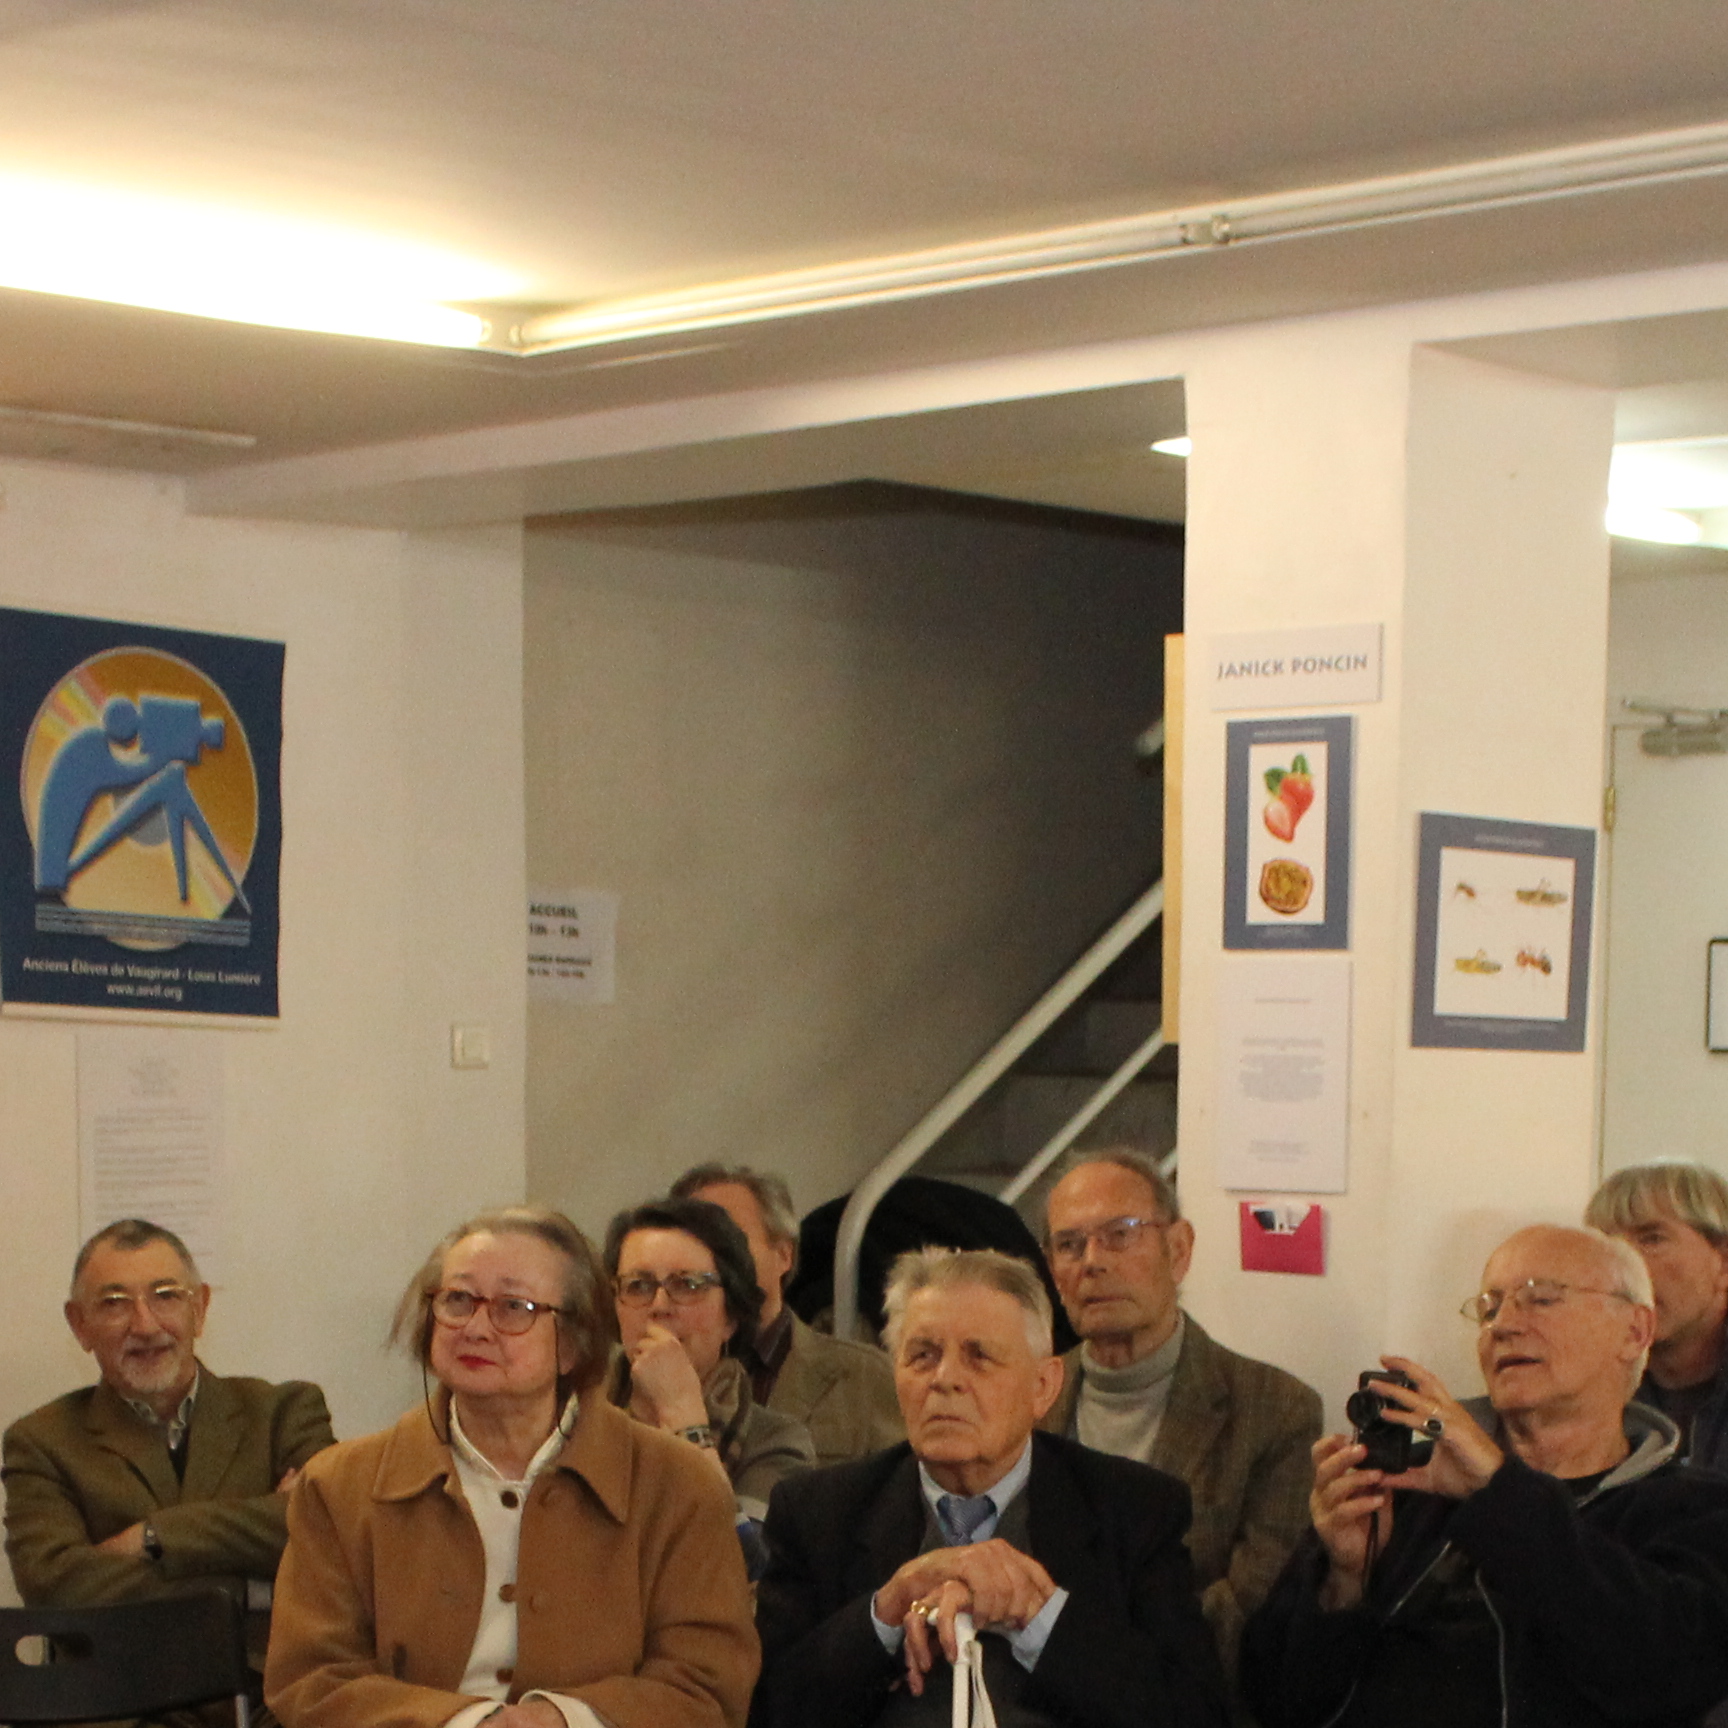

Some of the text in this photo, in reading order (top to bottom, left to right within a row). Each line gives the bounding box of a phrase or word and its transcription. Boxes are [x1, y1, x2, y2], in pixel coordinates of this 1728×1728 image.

[1217, 653, 1367, 681] JANICK PONCIN
[23, 957, 69, 973] Anciens
[127, 964, 179, 981] Vaugirard
